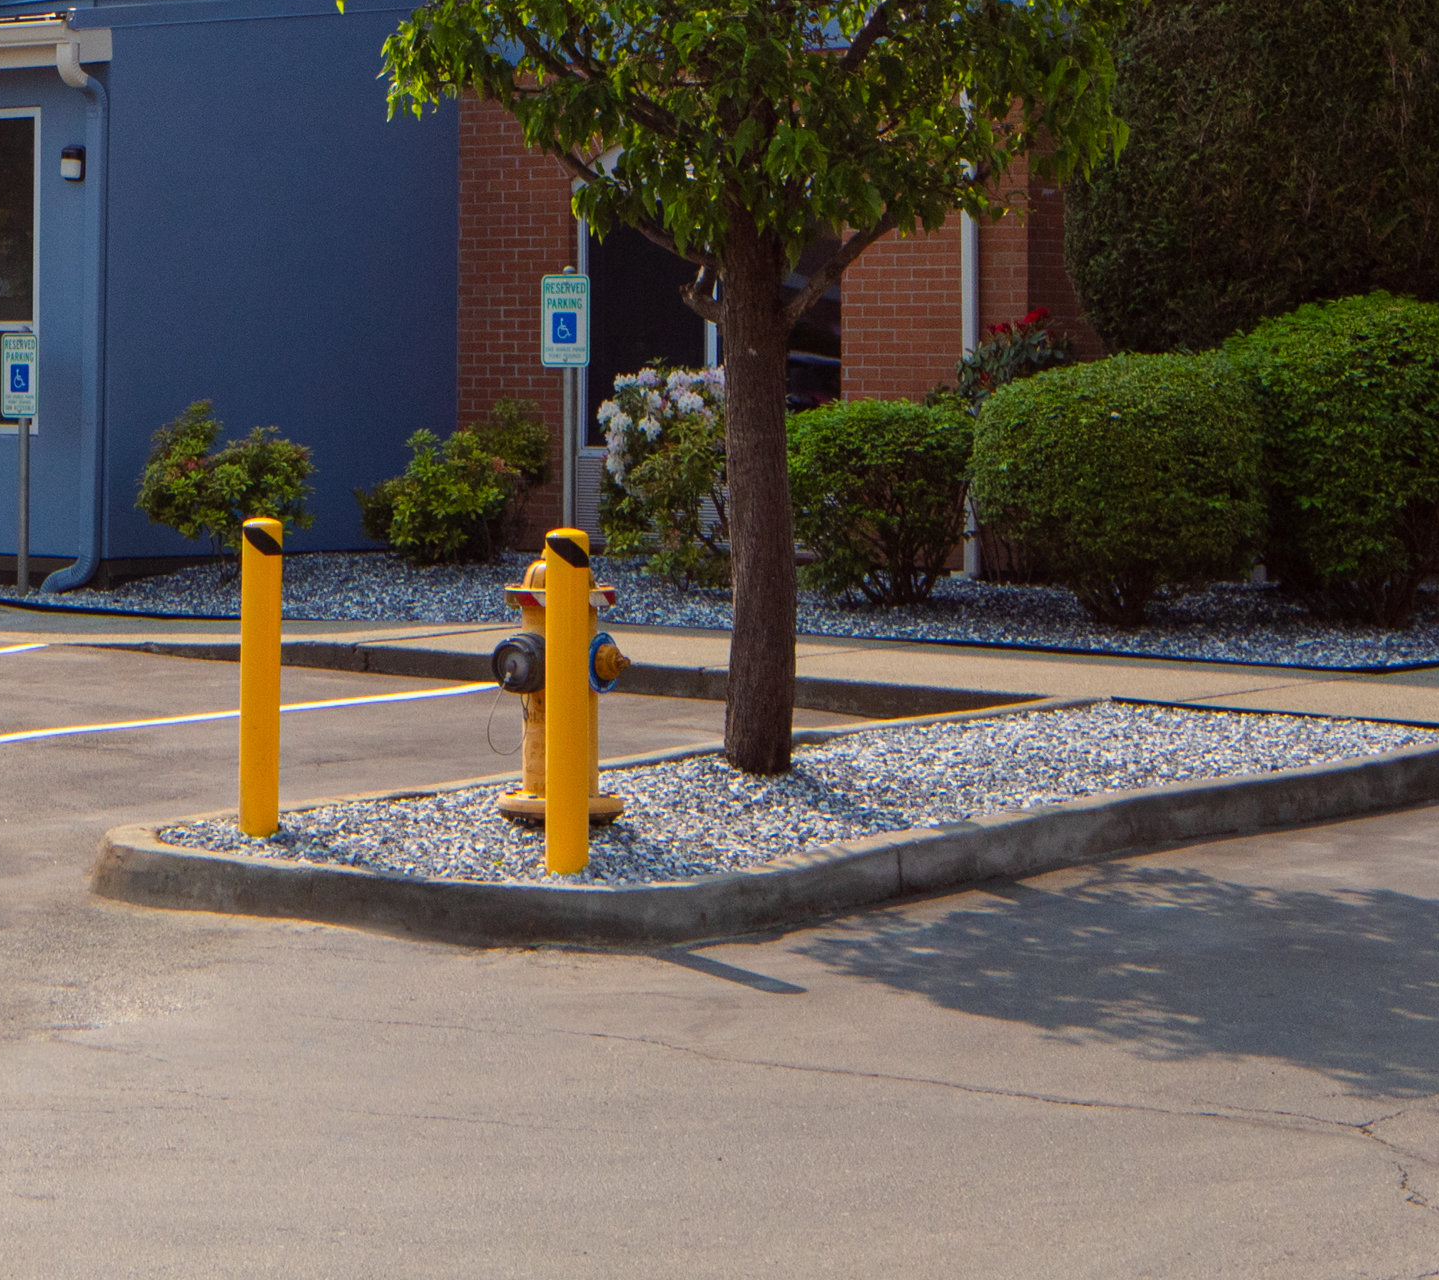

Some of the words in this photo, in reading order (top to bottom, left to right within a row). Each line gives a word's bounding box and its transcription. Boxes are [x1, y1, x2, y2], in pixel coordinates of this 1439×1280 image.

[545, 282, 586, 294] RESERVED
[547, 298, 583, 310] PARKING
[5, 339, 35, 350] RESERVED
[6, 352, 34, 362] PARKING
